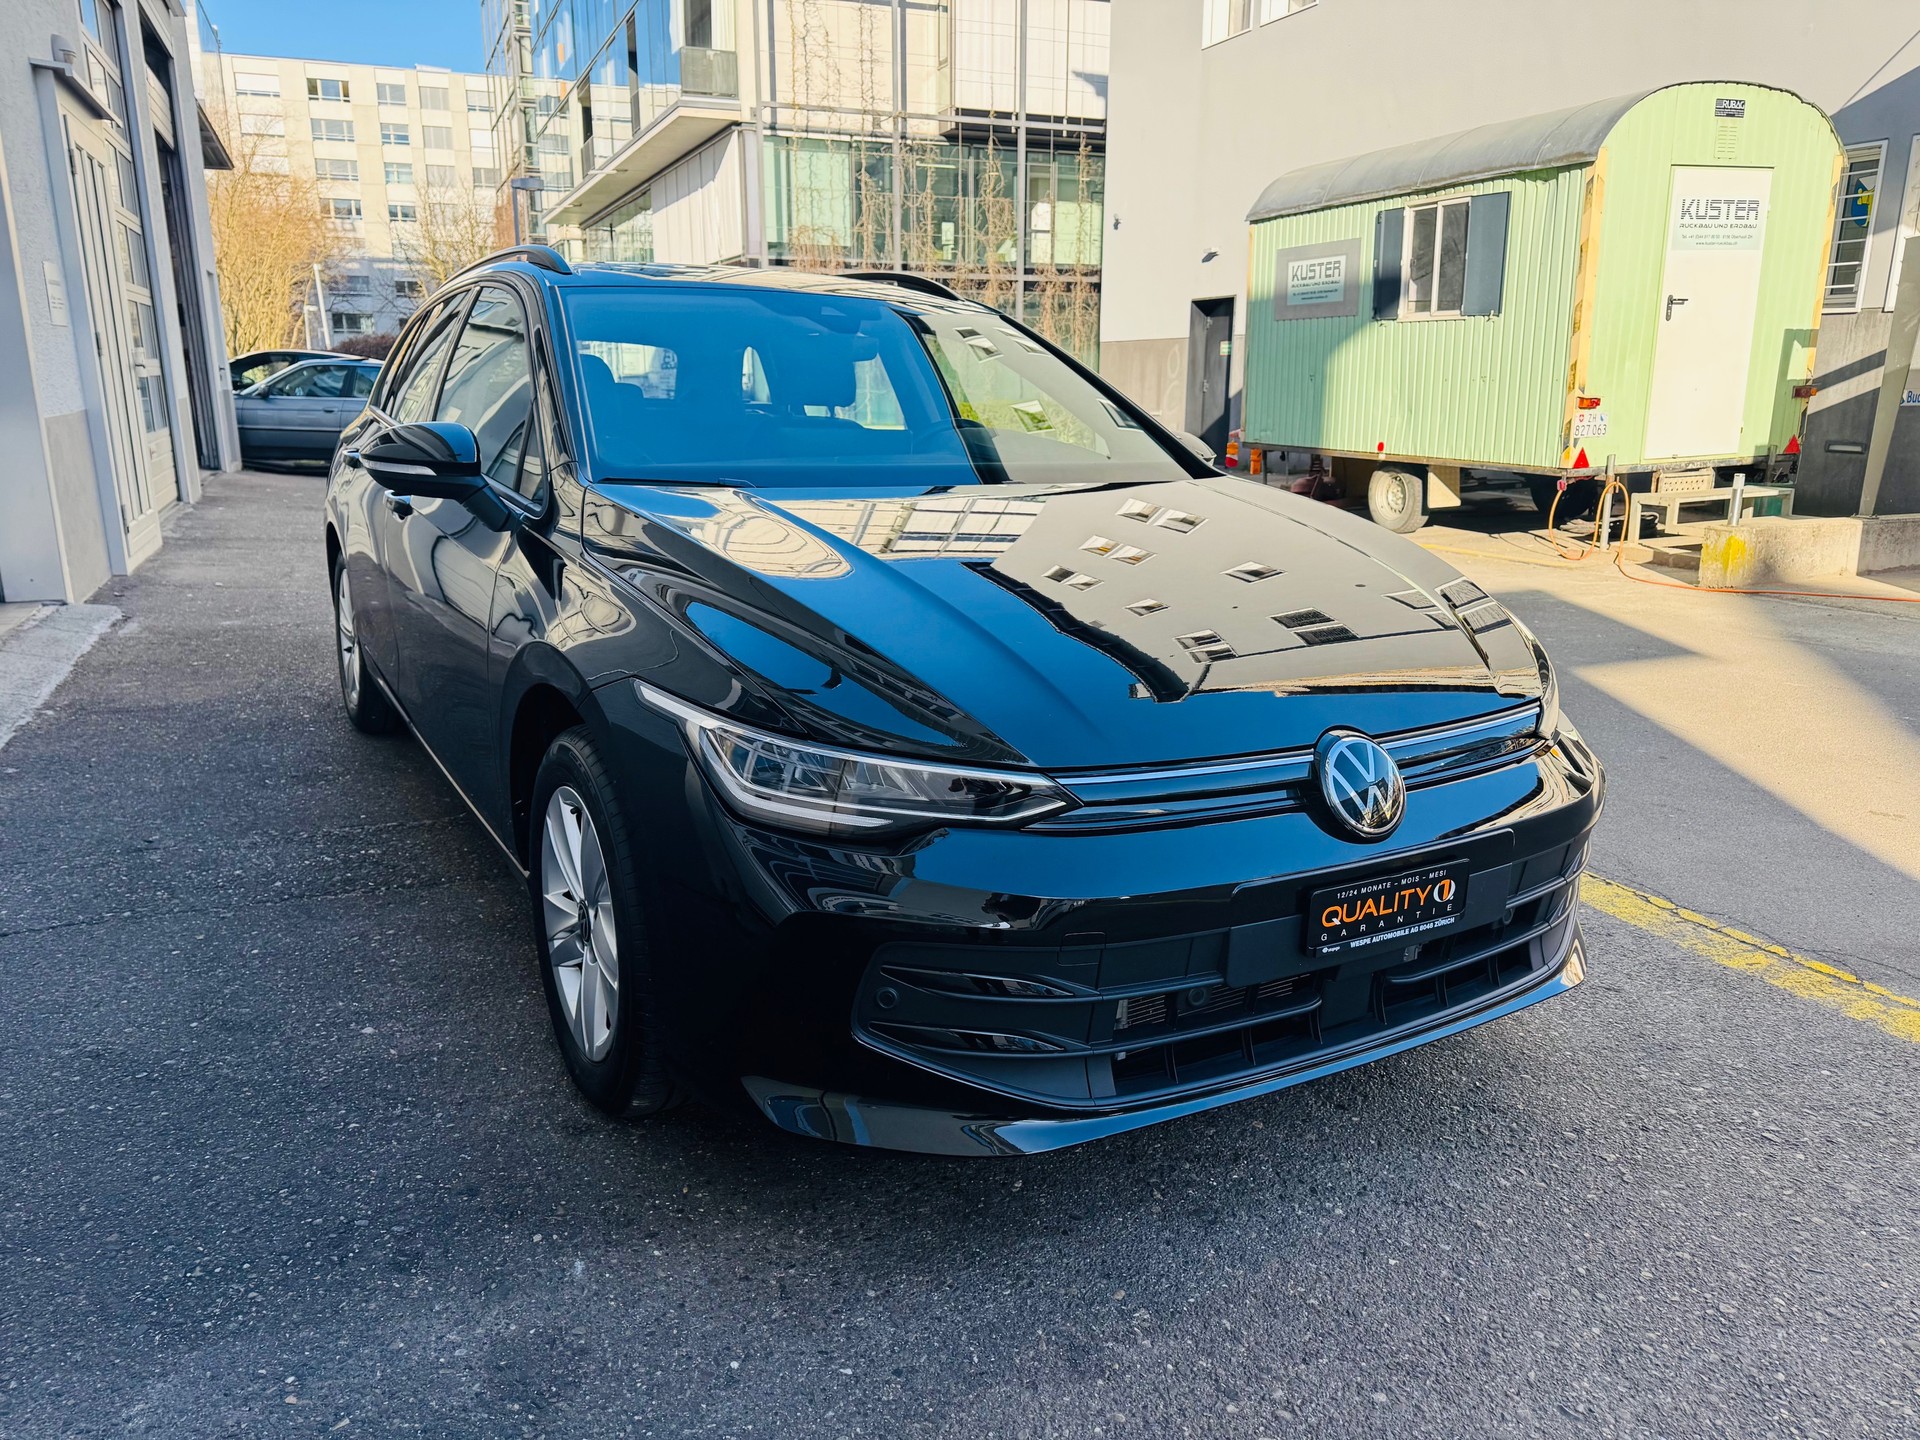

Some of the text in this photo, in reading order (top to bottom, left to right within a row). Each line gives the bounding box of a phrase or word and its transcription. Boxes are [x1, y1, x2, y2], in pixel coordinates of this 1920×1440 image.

[1723, 100, 1744, 109] RUBAG
[1680, 199, 1760, 220] KUSTER
[1292, 260, 1341, 281] KUSTER
[1588, 413, 1597, 423] ZH
[1337, 888, 1358, 899] 12/24
[1361, 881, 1392, 894] MONATE
[1401, 876, 1420, 885] MOIS
[1429, 870, 1447, 879] MESI
[1321, 884, 1432, 928] QUALITY
[1320, 903, 1453, 942] GARANTIE
[1350, 937, 1372, 948] WESPE
[1372, 927, 1410, 943] AUTOMOBILE
[1410, 925, 1419, 934] AG
[1434, 917, 1455, 930] ZÜRICH
